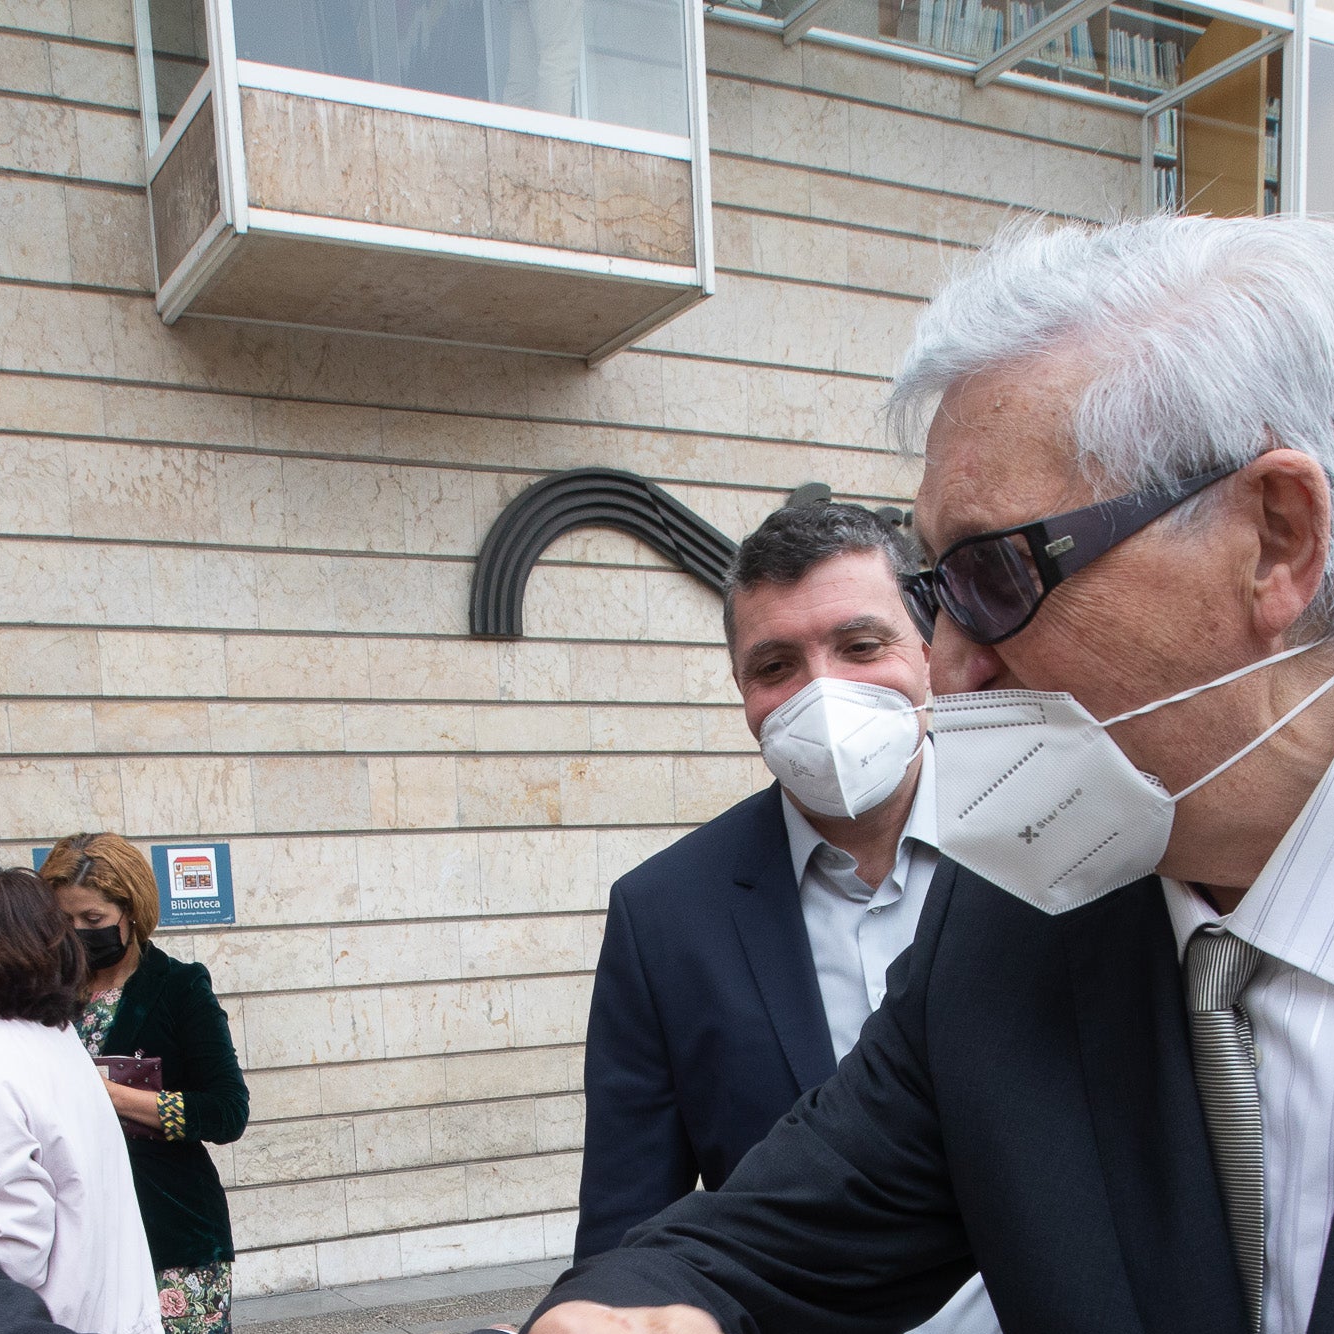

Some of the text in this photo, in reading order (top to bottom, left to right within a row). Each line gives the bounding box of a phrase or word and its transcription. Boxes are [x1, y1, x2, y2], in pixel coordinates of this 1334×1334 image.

[1036, 788, 1083, 829] Star Care
[171, 899, 220, 909] Biblioteca
